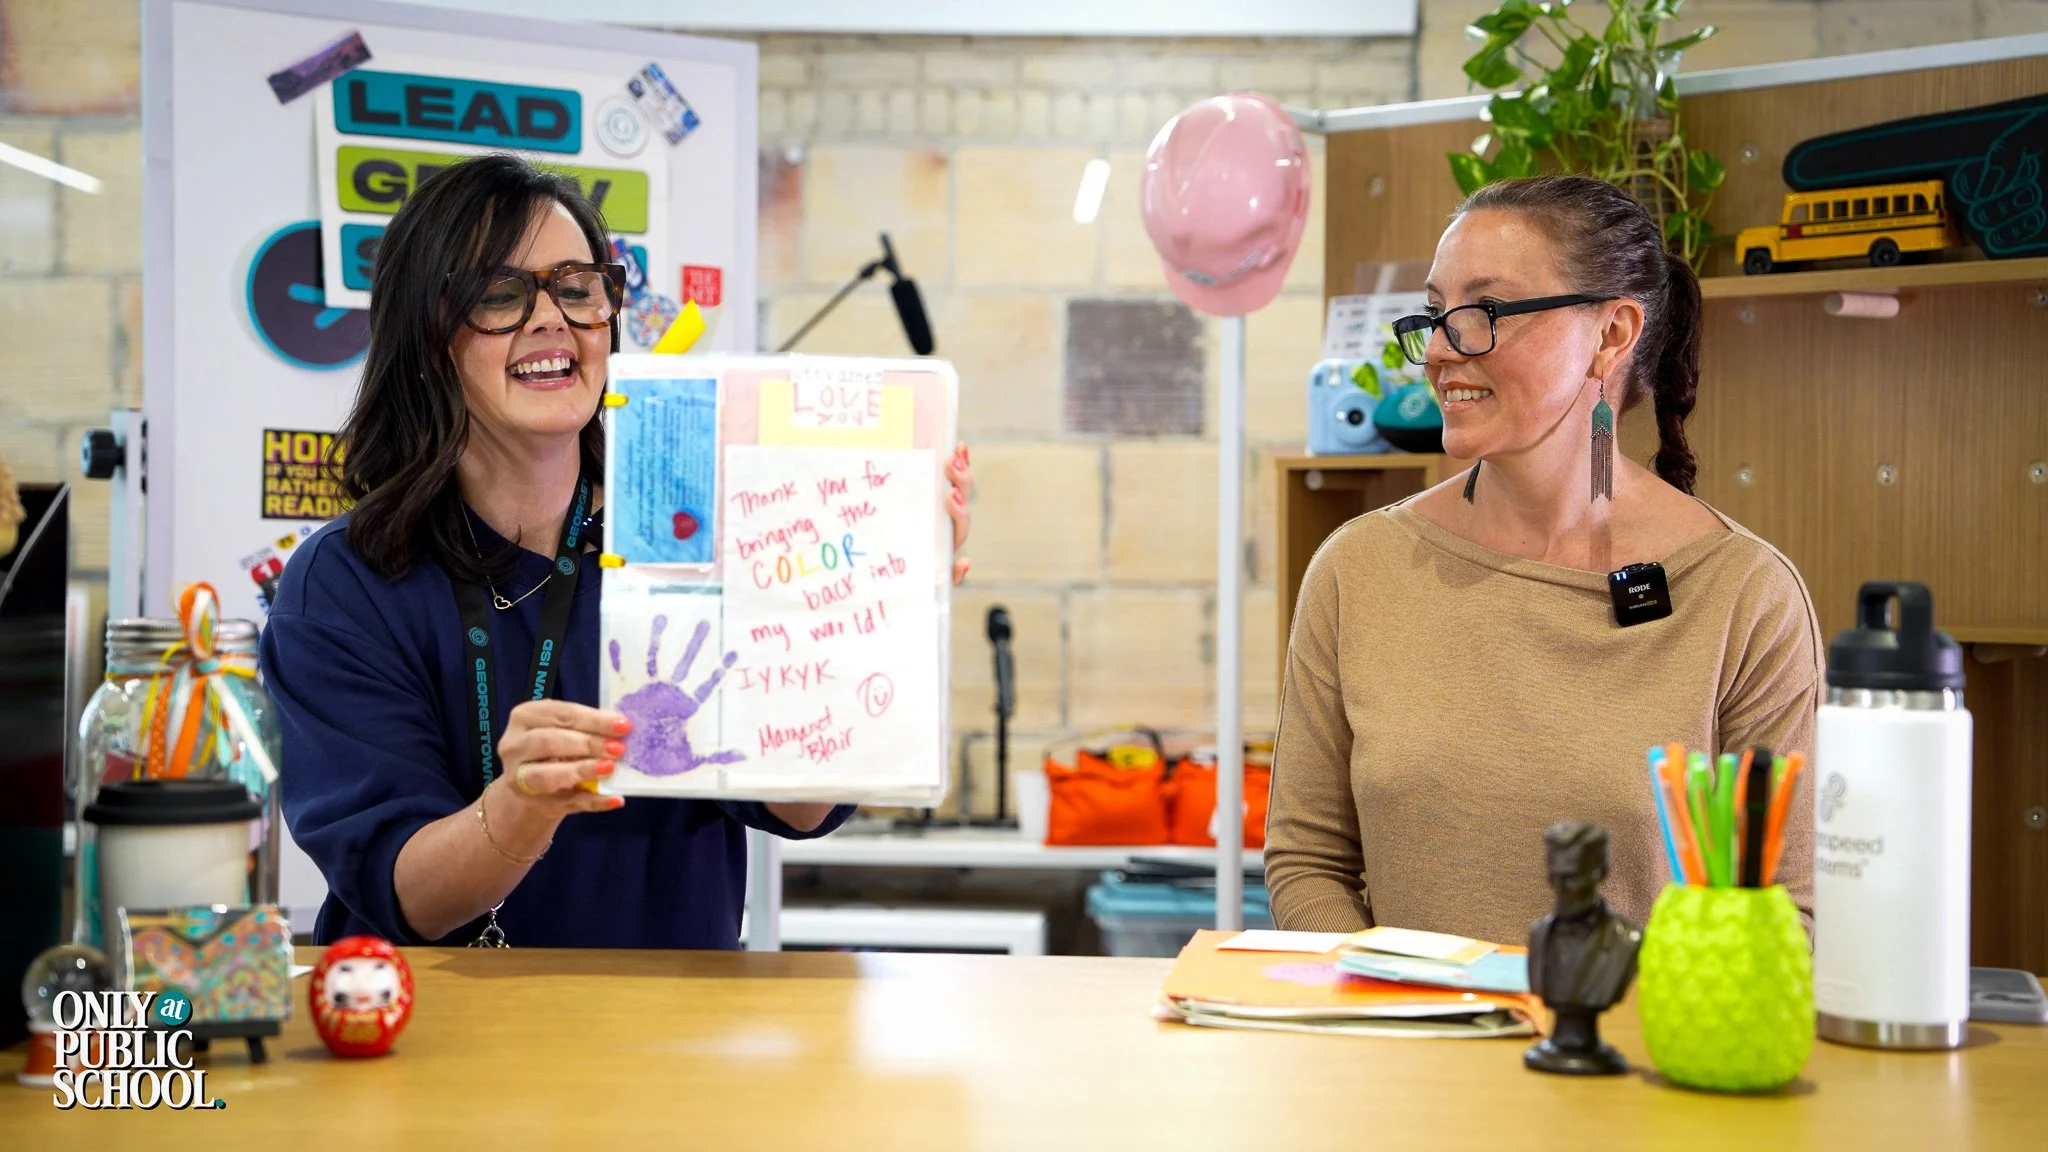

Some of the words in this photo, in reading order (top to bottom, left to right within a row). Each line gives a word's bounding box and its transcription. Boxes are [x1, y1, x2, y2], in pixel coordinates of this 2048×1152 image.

[348, 80, 570, 140] LEAD
[792, 382, 883, 418] LOVE
[566, 475, 589, 548] GEORGET
[731, 481, 798, 518] Thank
[816, 477, 848, 506] you
[861, 460, 892, 490] for
[736, 518, 820, 560] bringing
[836, 501, 877, 527] the
[752, 533, 867, 590] COLOR
[803, 571, 856, 611] back
[869, 551, 907, 578] into
[539, 639, 554, 667] ISD
[750, 623, 792, 652] my
[736, 658, 837, 694] IYKYK
[807, 727, 855, 765] Blair
